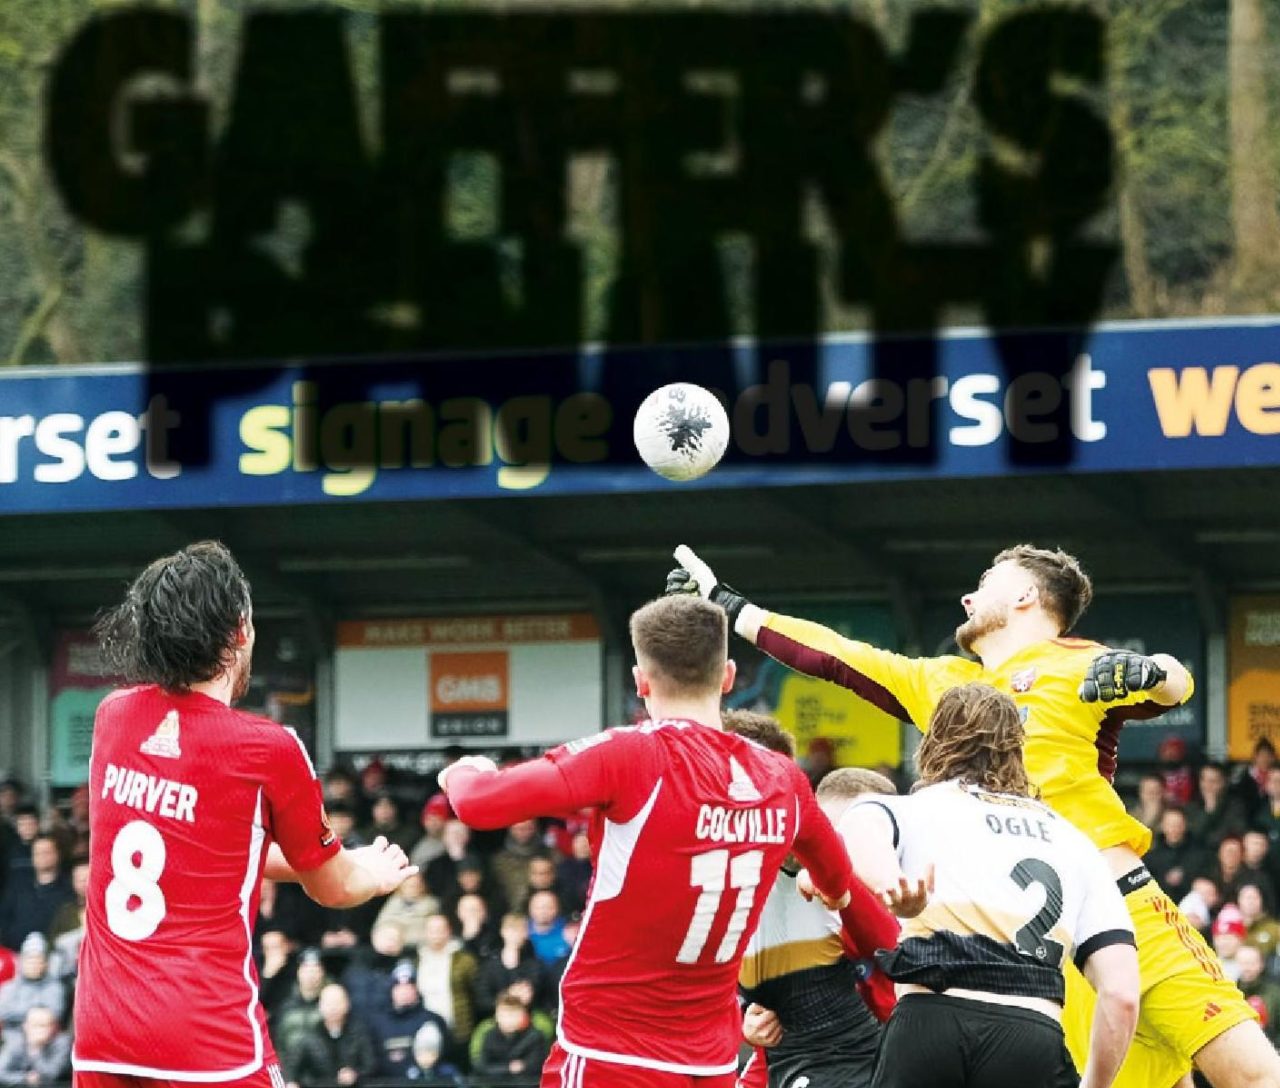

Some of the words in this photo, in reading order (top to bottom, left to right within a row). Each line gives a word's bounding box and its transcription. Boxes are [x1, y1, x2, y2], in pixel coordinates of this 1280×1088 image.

[239, 382, 612, 496] signage
[706, 355, 1107, 456] dverset
[102, 763, 198, 823] PURVER
[696, 804, 787, 844] COLVILLE
[986, 814, 1052, 843] OGLE
[105, 820, 166, 941] 8
[676, 850, 764, 964] 11
[1010, 858, 1064, 966] 2
